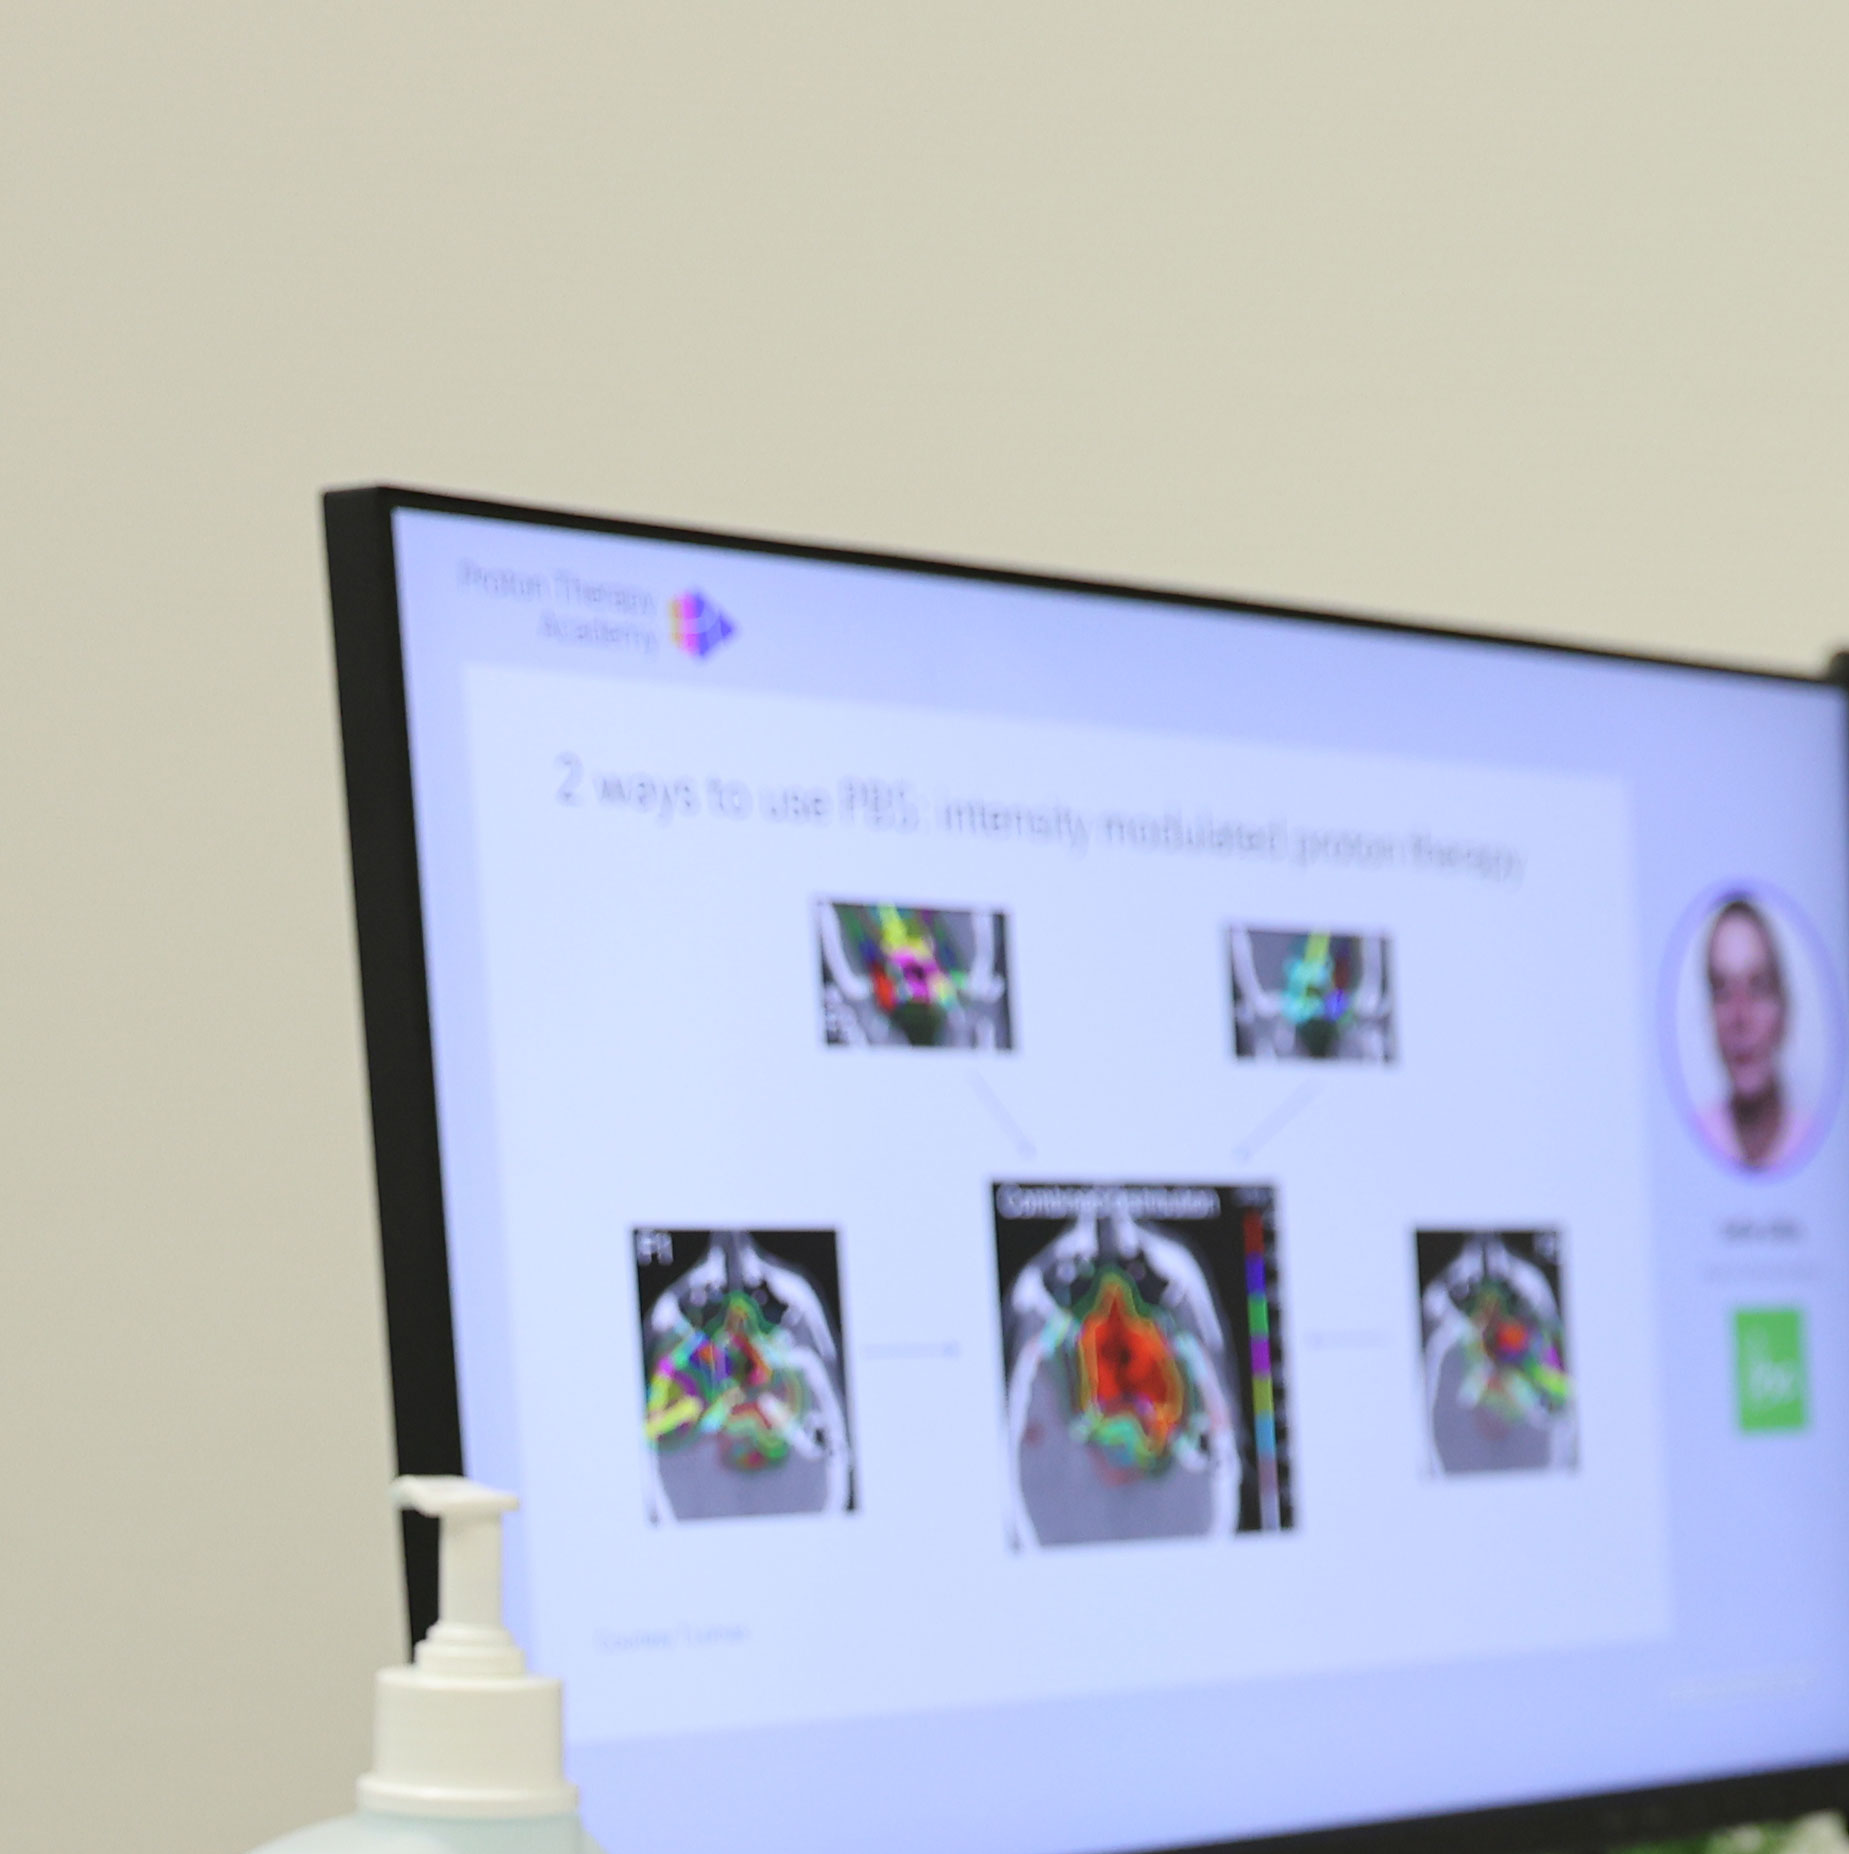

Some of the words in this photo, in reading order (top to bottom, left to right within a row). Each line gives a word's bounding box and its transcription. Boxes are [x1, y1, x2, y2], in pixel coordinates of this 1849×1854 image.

[555, 751, 583, 806] 2
[594, 771, 700, 827] ways
[706, 775, 752, 820] to
[761, 784, 832, 827] use
